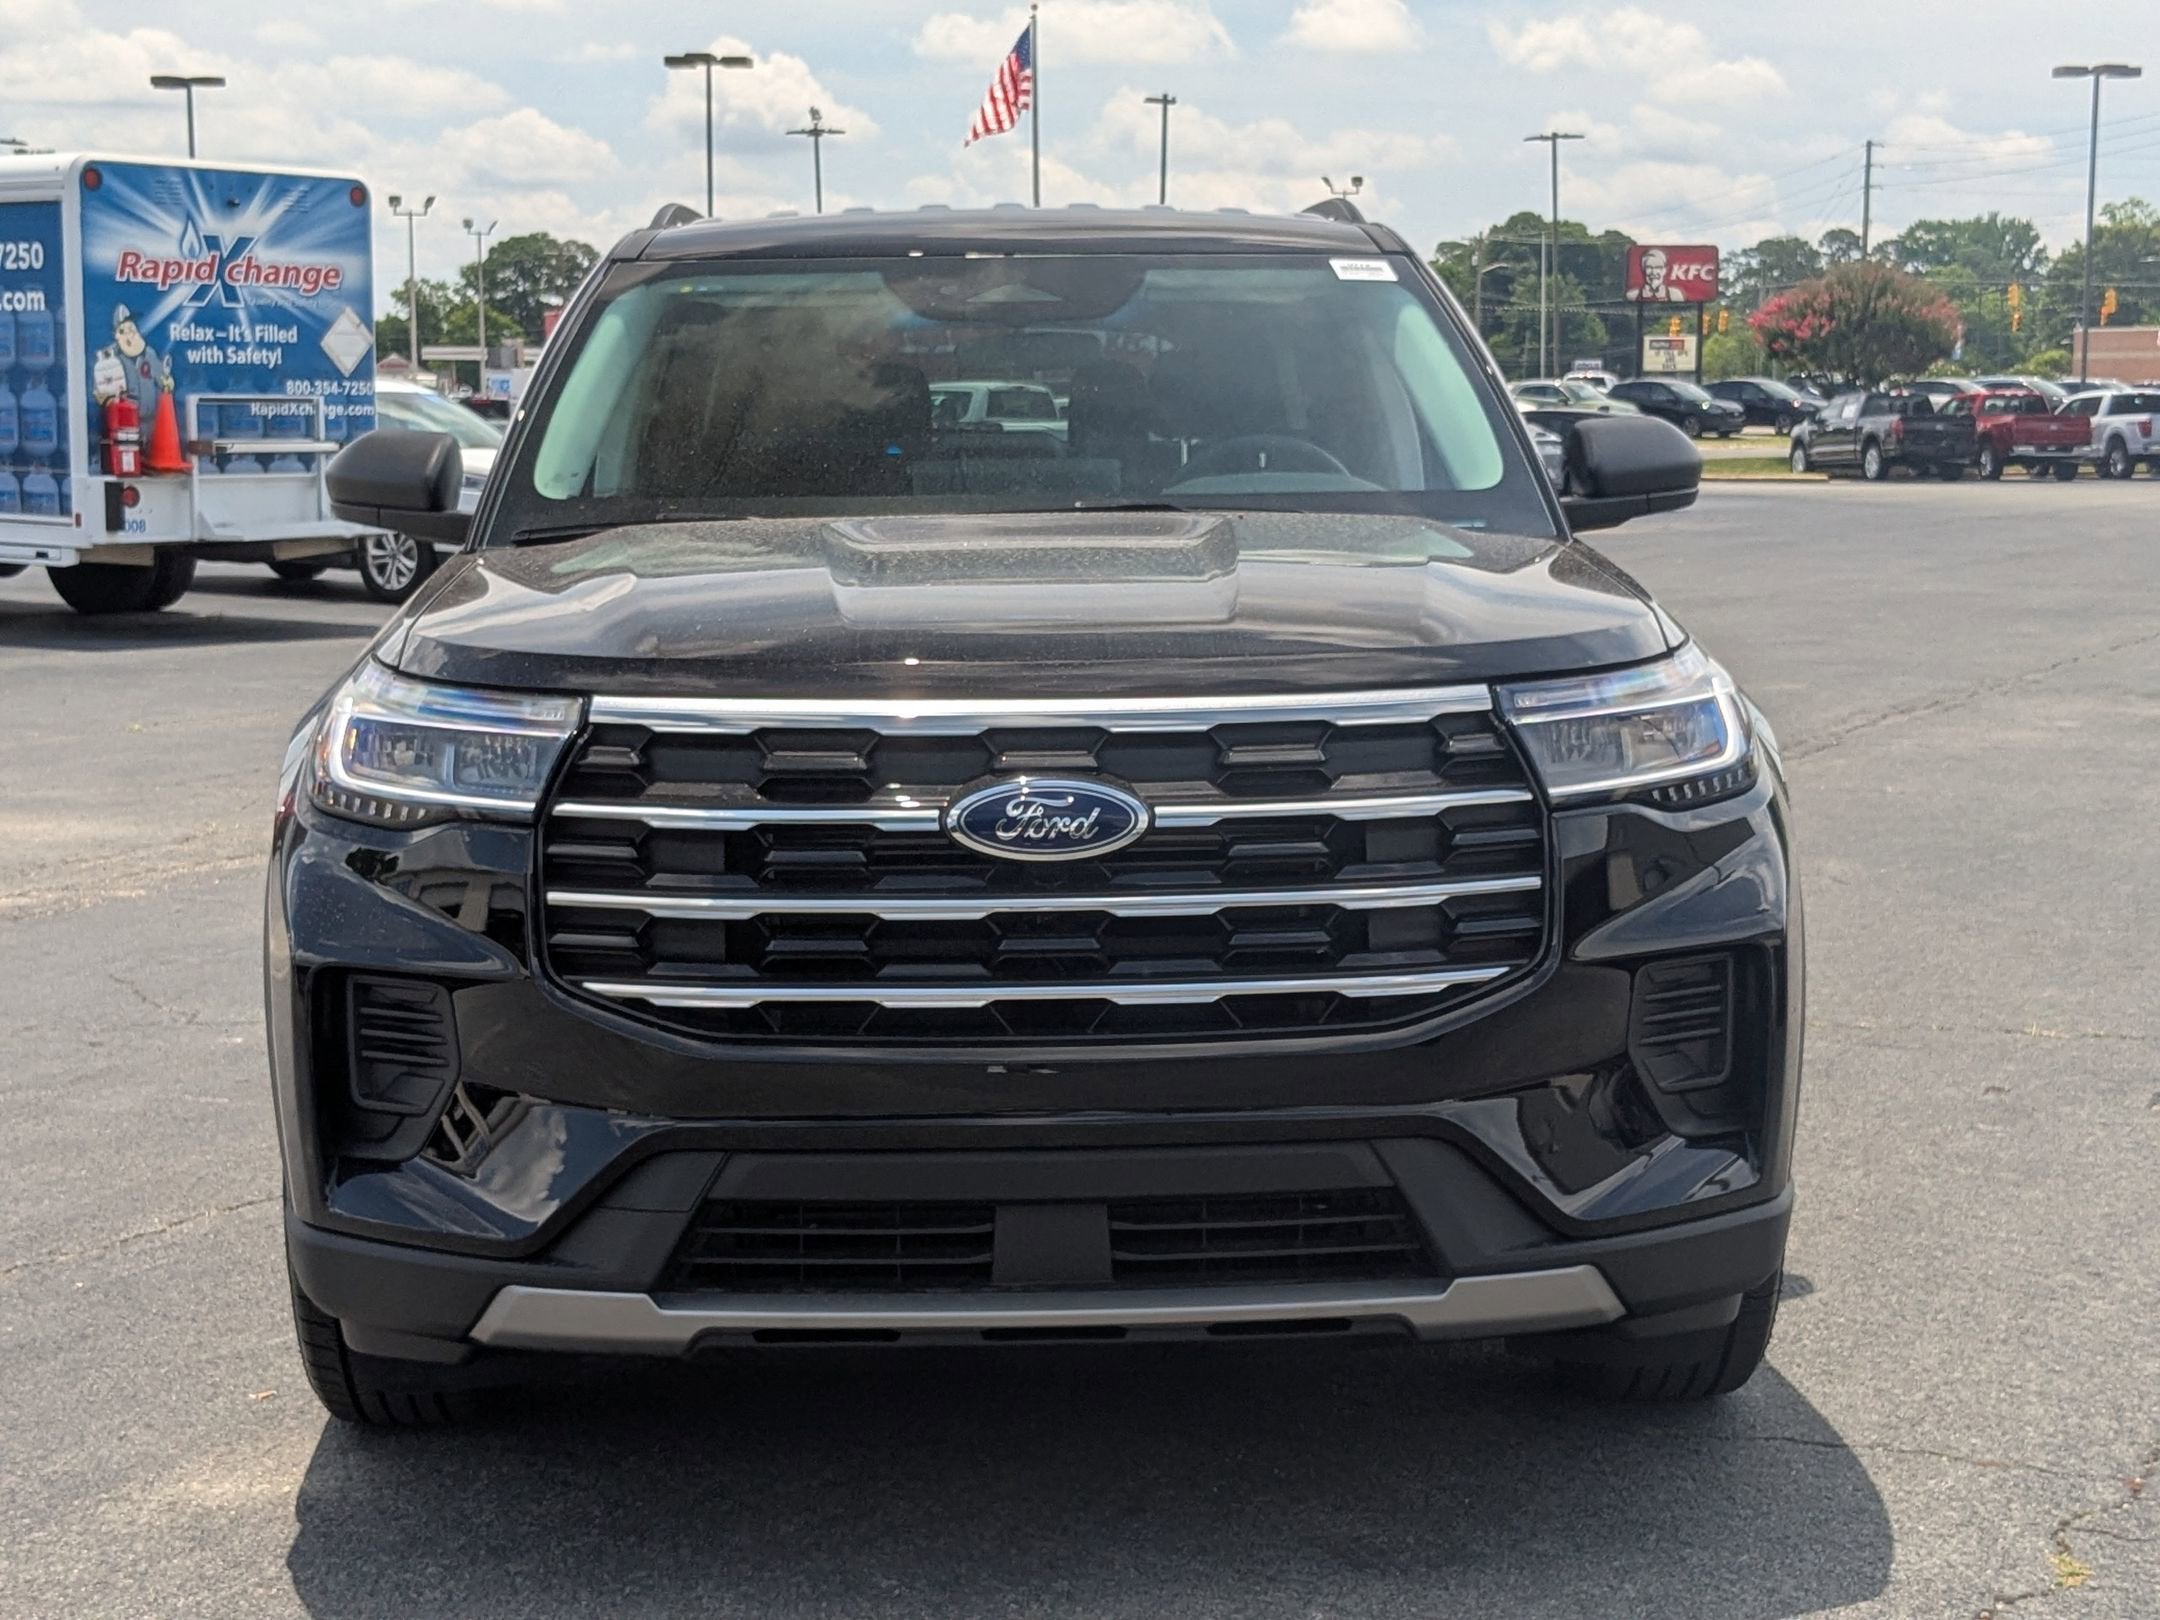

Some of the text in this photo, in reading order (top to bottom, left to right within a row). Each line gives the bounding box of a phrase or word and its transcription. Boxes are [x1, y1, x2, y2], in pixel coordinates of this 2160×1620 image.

[115, 249, 220, 291] Rapid
[1670, 264, 1714, 281] KFC
[254, 324, 298, 344] Filled
[187, 345, 283, 370] with Safety!
[286, 379, 374, 397] 800-354-7250
[994, 796, 1102, 840] Ford
